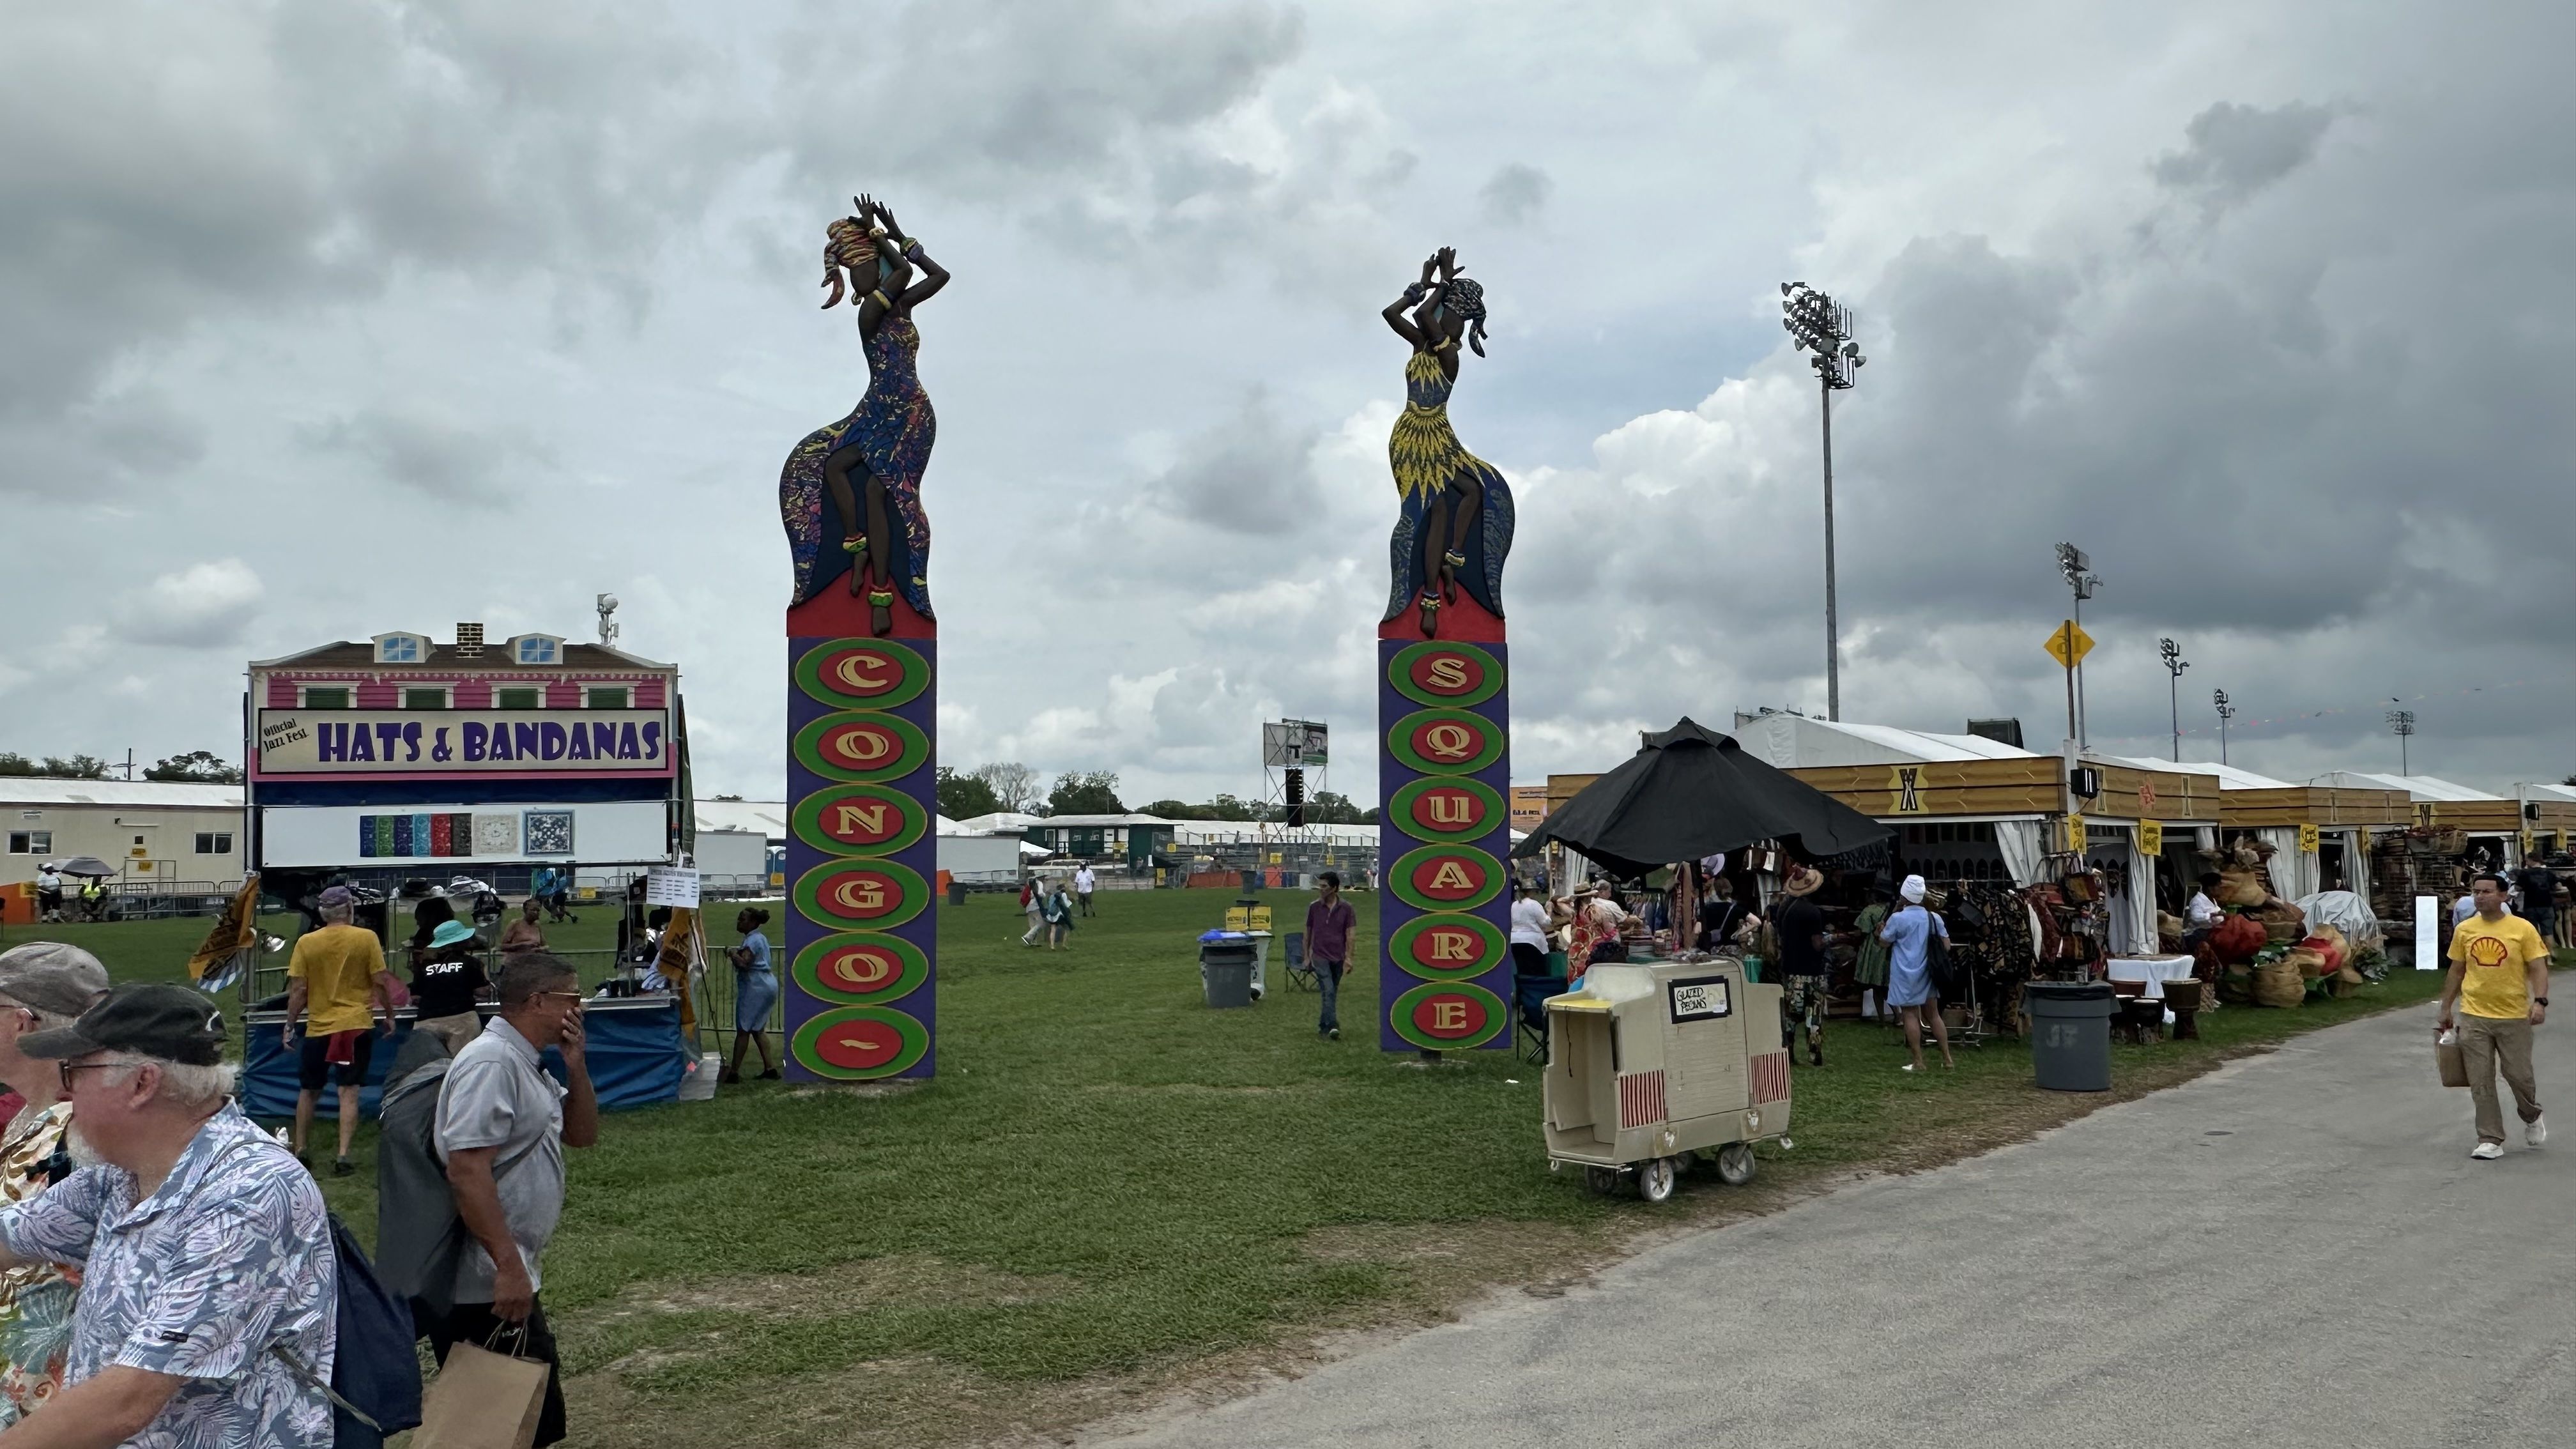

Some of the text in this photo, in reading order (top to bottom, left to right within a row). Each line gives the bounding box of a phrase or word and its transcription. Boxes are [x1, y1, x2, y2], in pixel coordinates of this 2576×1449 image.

[263, 718, 298, 737] Official
[263, 728, 310, 753] Jazz Fest
[318, 721, 661, 762] HATS & BANDANAS
[835, 656, 889, 982] CONGO
[1427, 659, 1474, 1029] SQUARE
[425, 962, 463, 976] STAFF
